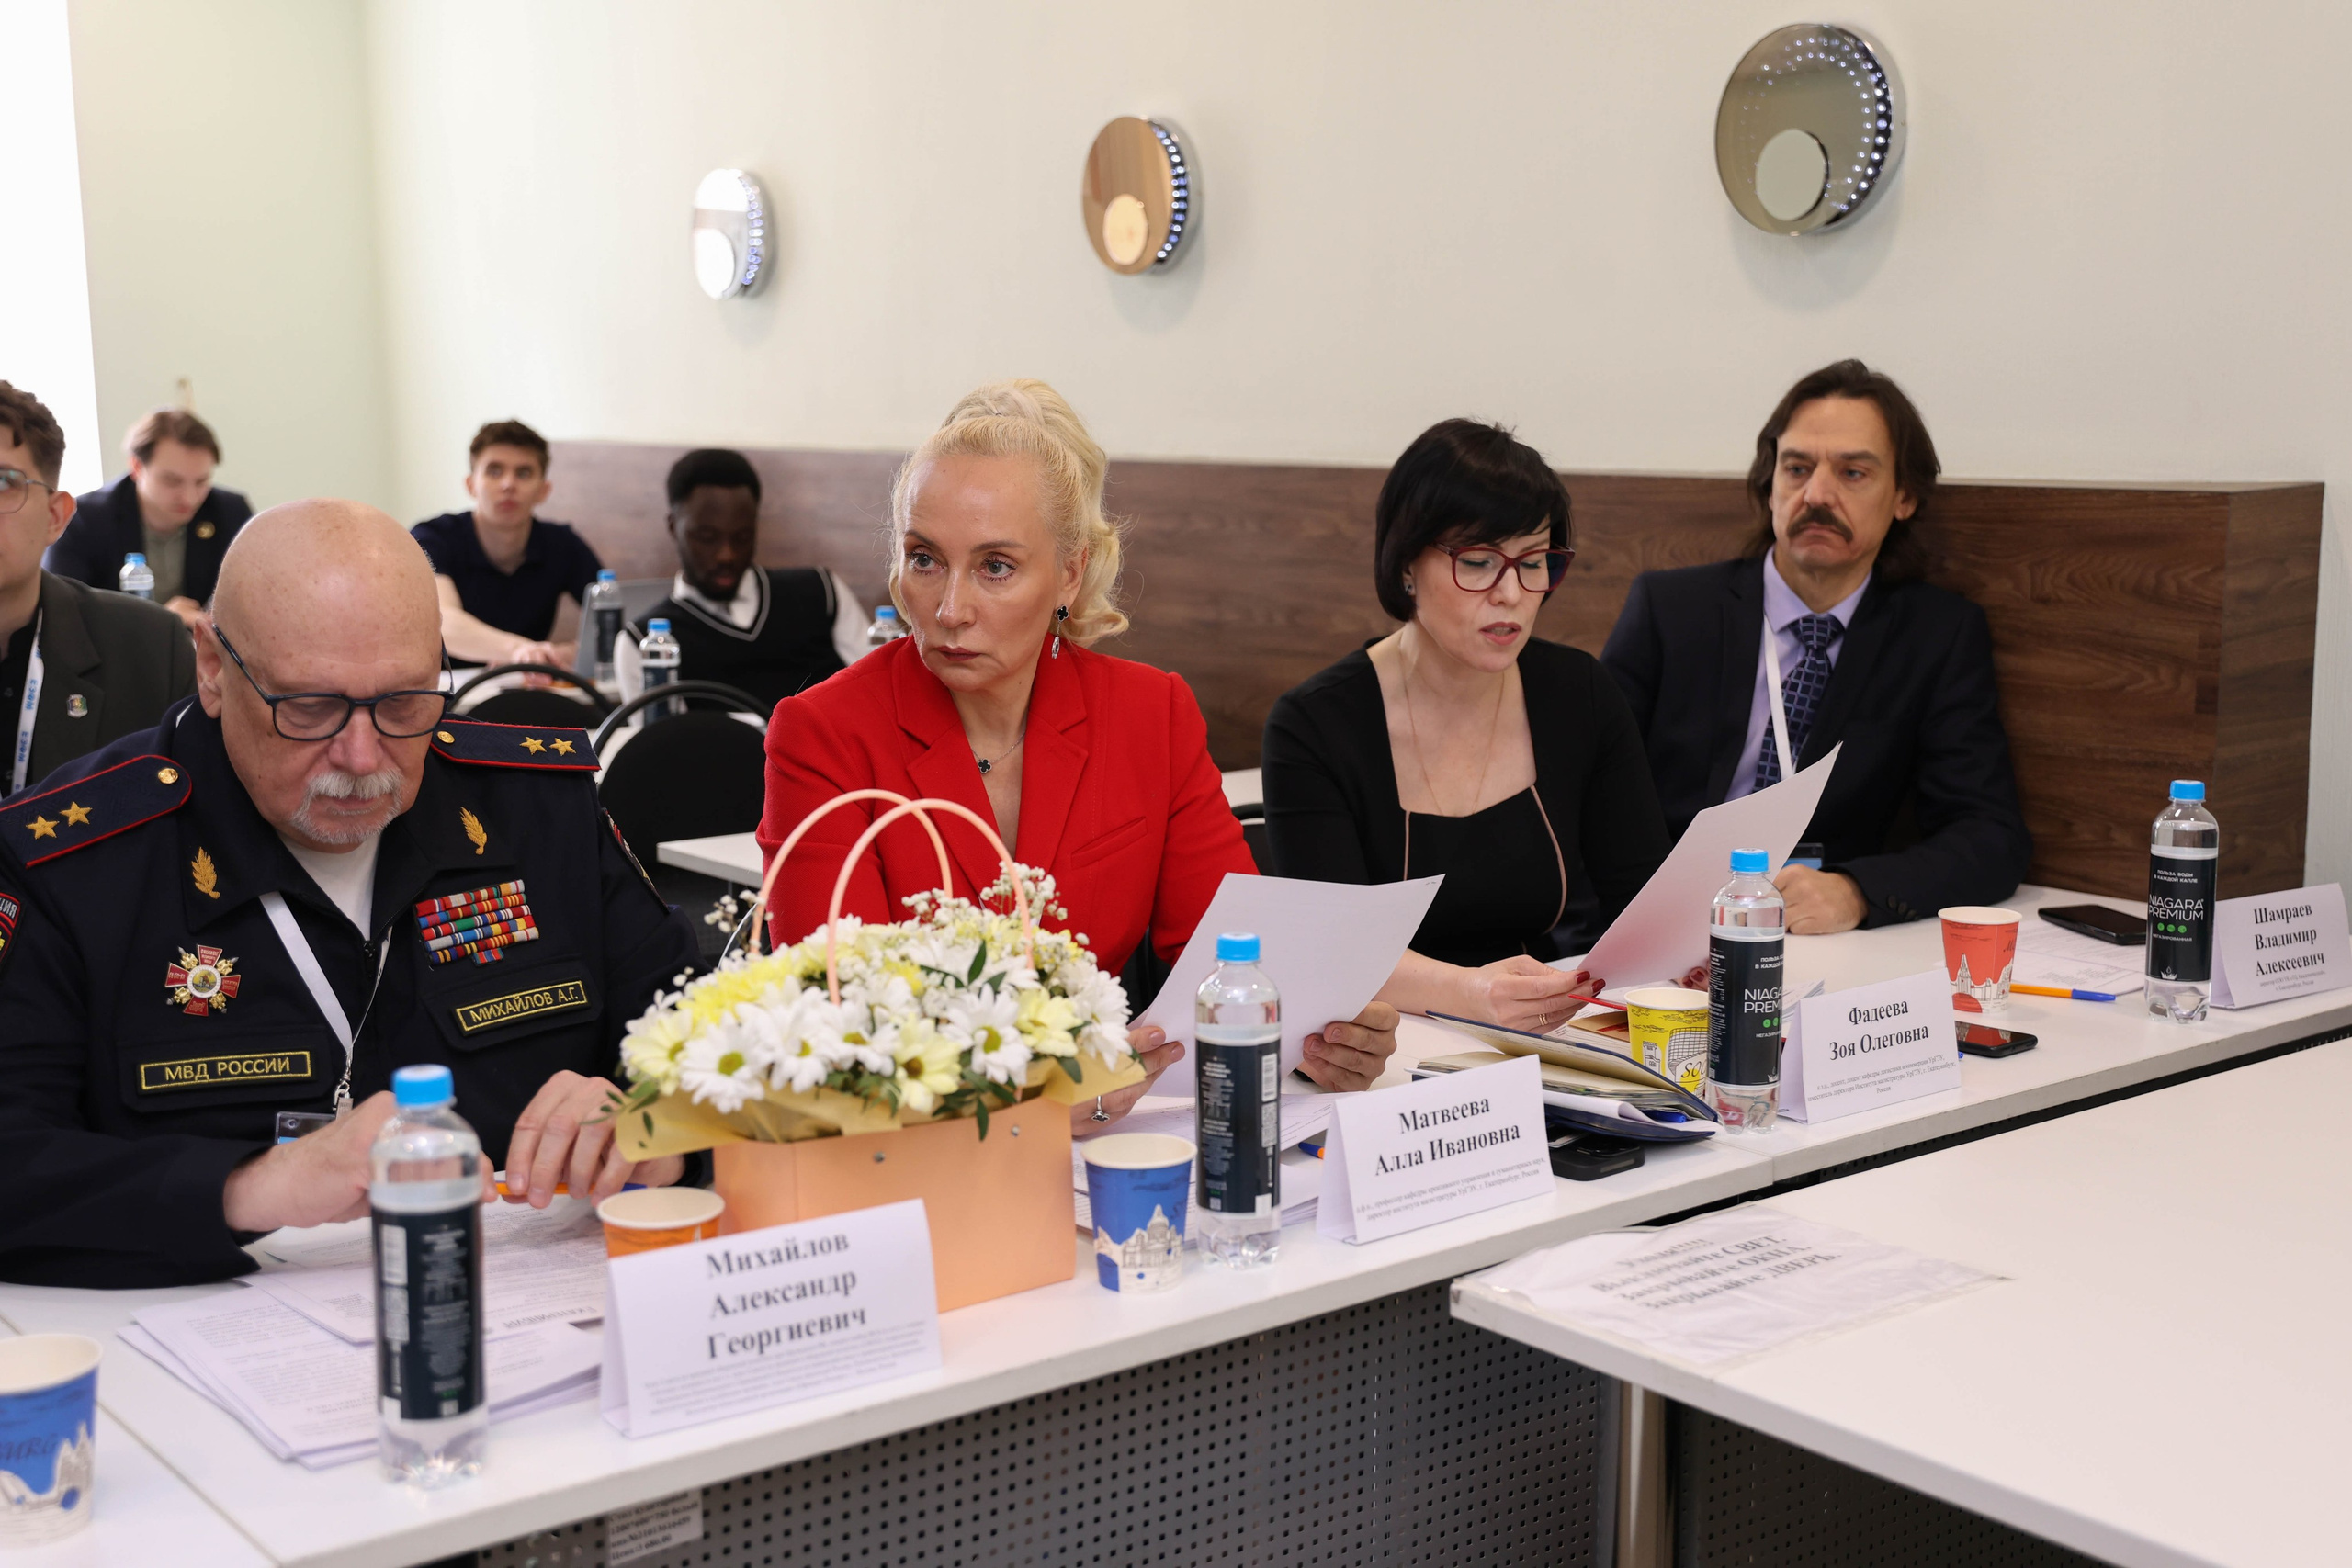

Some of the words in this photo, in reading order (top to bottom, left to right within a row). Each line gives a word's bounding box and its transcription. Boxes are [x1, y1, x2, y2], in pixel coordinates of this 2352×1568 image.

[2156, 869, 2177, 877] ПОЛЬЗА
[2149, 905, 2204, 920] PREMIUM
[2254, 904, 2312, 924] Шамраев
[2255, 929, 2317, 950] Владимир
[2256, 953, 2325, 976] Алексеевич
[469, 992, 554, 1023] МИХАЙЛОВ
[558, 987, 579, 1003] А.Г.
[1744, 986, 1782, 1001] NIAGA
[1744, 1000, 1781, 1014] PREM
[1849, 999, 1909, 1026] Фадеева
[1829, 1041, 1856, 1061] Зоя
[1860, 1025, 1929, 1053] Олеговна
[164, 1063, 209, 1081] МВД
[217, 1057, 290, 1077] РОССИИ
[1398, 1098, 1490, 1134] Матвеева
[1375, 1149, 1424, 1176] Алла
[1428, 1124, 1520, 1162] Ивановна
[705, 1233, 851, 1279] Михайлов
[1721, 1235, 1787, 1256] СВЕТ.
[1615, 1262, 1741, 1301] Закрывайте
[1737, 1245, 1812, 1266] ОКНА.
[1637, 1273, 1766, 1309] Закрывайте
[1762, 1253, 1843, 1279] ДВЕРЬ.
[709, 1270, 857, 1319] Александр
[706, 1307, 867, 1360] Георгиевич
